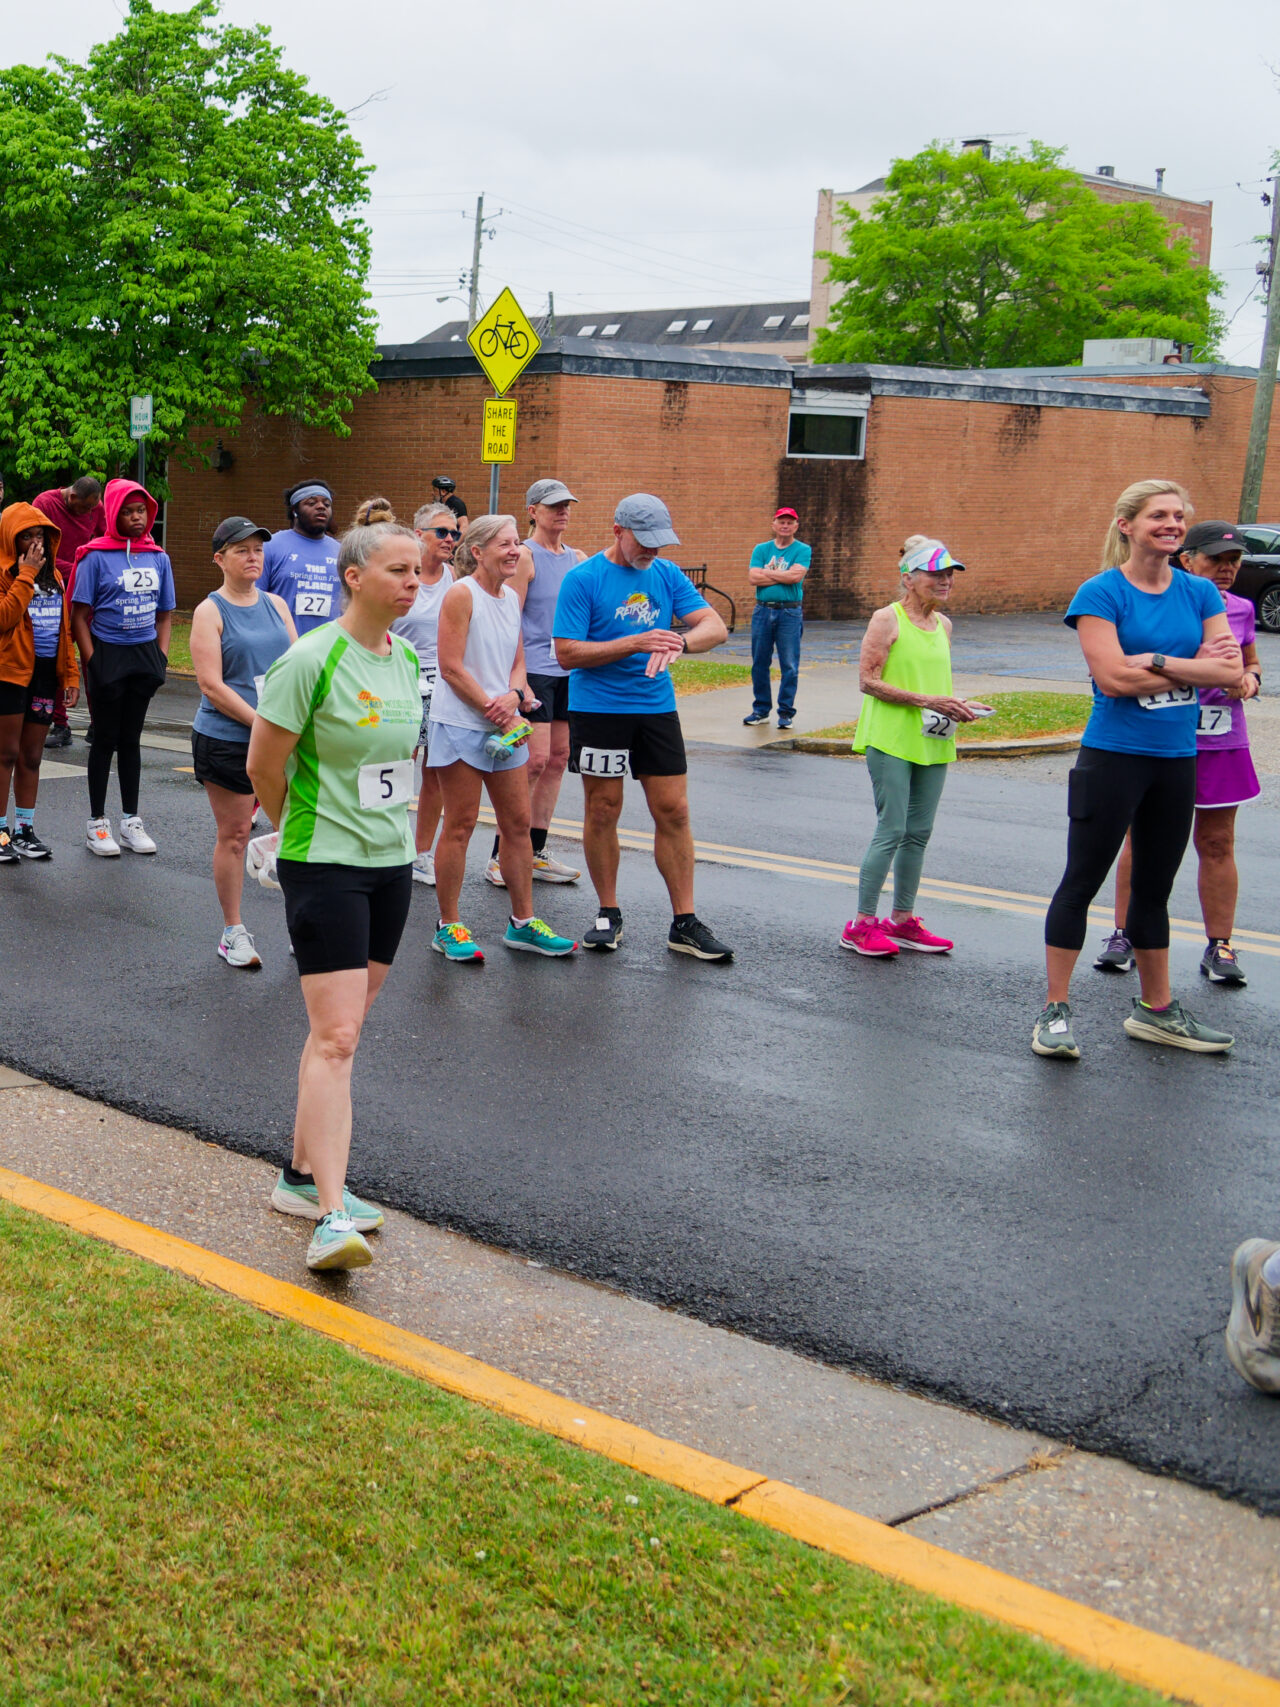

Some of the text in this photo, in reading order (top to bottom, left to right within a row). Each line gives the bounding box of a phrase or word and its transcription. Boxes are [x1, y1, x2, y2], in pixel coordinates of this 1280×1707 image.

[135, 412, 148, 421] HOUR
[487, 407, 513, 420] SHARE
[492, 425, 506, 437] THE
[488, 443, 509, 455] ROAD
[132, 571, 153, 588] 25
[304, 597, 326, 612] 27
[614, 600, 649, 621] RETRO
[637, 608, 660, 625] RUN
[927, 715, 951, 737] 22
[585, 752, 627, 774] 113
[380, 768, 394, 799] 5
